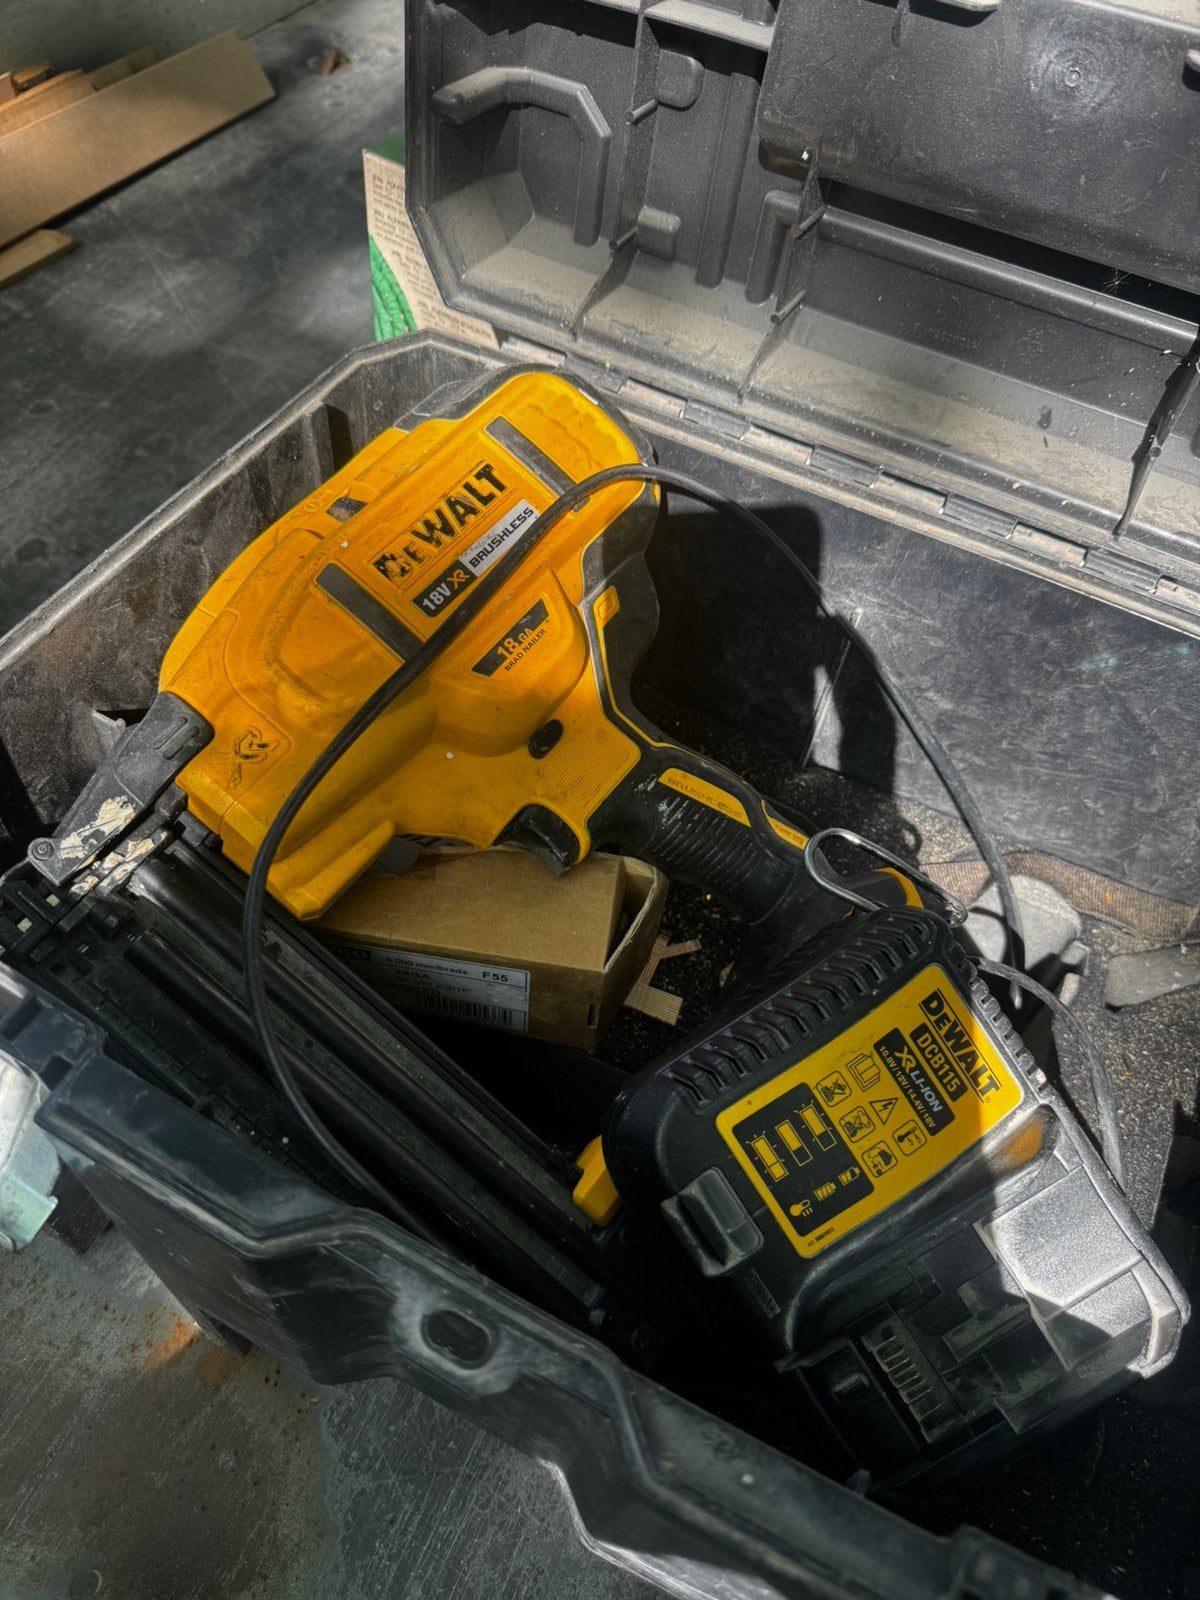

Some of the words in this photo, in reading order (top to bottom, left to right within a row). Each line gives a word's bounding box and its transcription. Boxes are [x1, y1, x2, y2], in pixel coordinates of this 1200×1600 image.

[422, 583, 453, 613] 18V
[446, 568, 471, 591] XR
[469, 506, 535, 569] BRUSHLESS
[496, 636, 521, 662] 18
[518, 627, 536, 645] GA
[504, 652, 524, 672] BRAD
[522, 628, 547, 655] NAILER
[482, 971, 508, 983] F55
[916, 1033, 960, 1093] DCB115
[921, 990, 1001, 1097] DEWALT
[894, 1045, 917, 1073] XR
[909, 1070, 944, 1113] LI-ION
